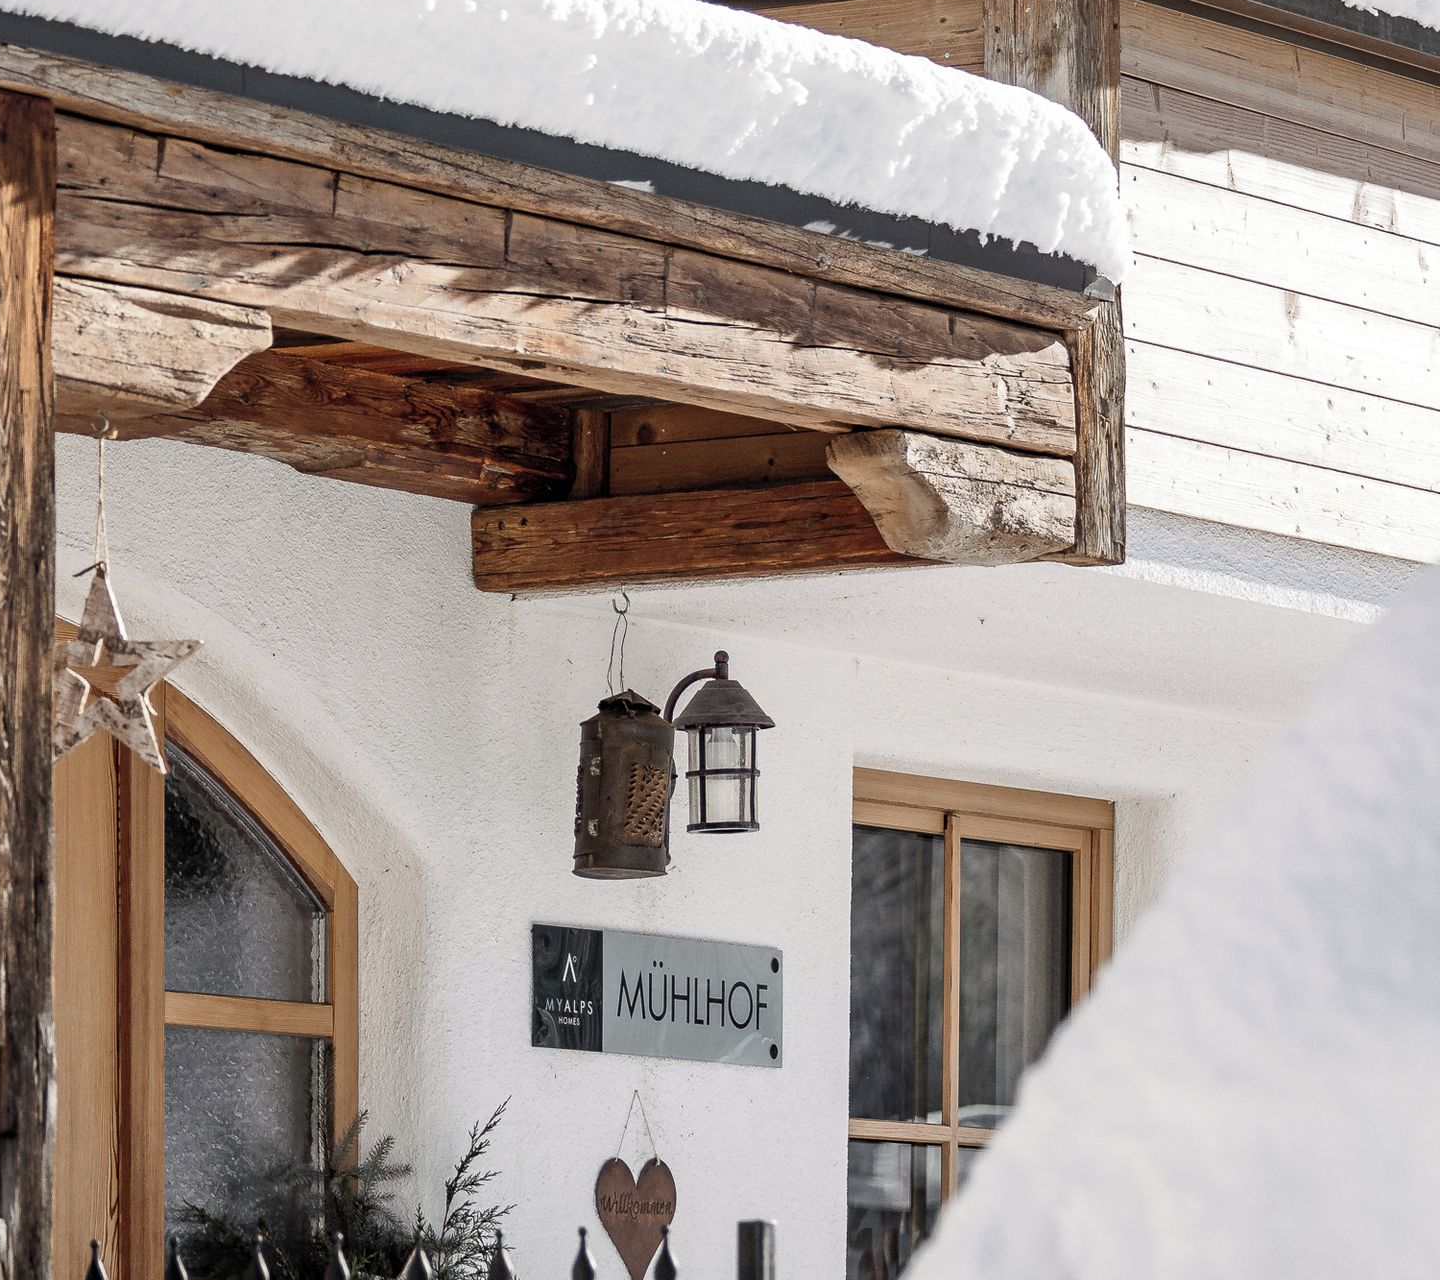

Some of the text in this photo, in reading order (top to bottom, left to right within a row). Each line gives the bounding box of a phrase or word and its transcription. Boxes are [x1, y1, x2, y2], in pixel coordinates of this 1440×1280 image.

[545, 997, 593, 1015] MYALPS
[617, 960, 768, 1030] MÜHLHOF
[558, 1016, 580, 1026] HOMES
[600, 1192, 673, 1219] Willkommen
